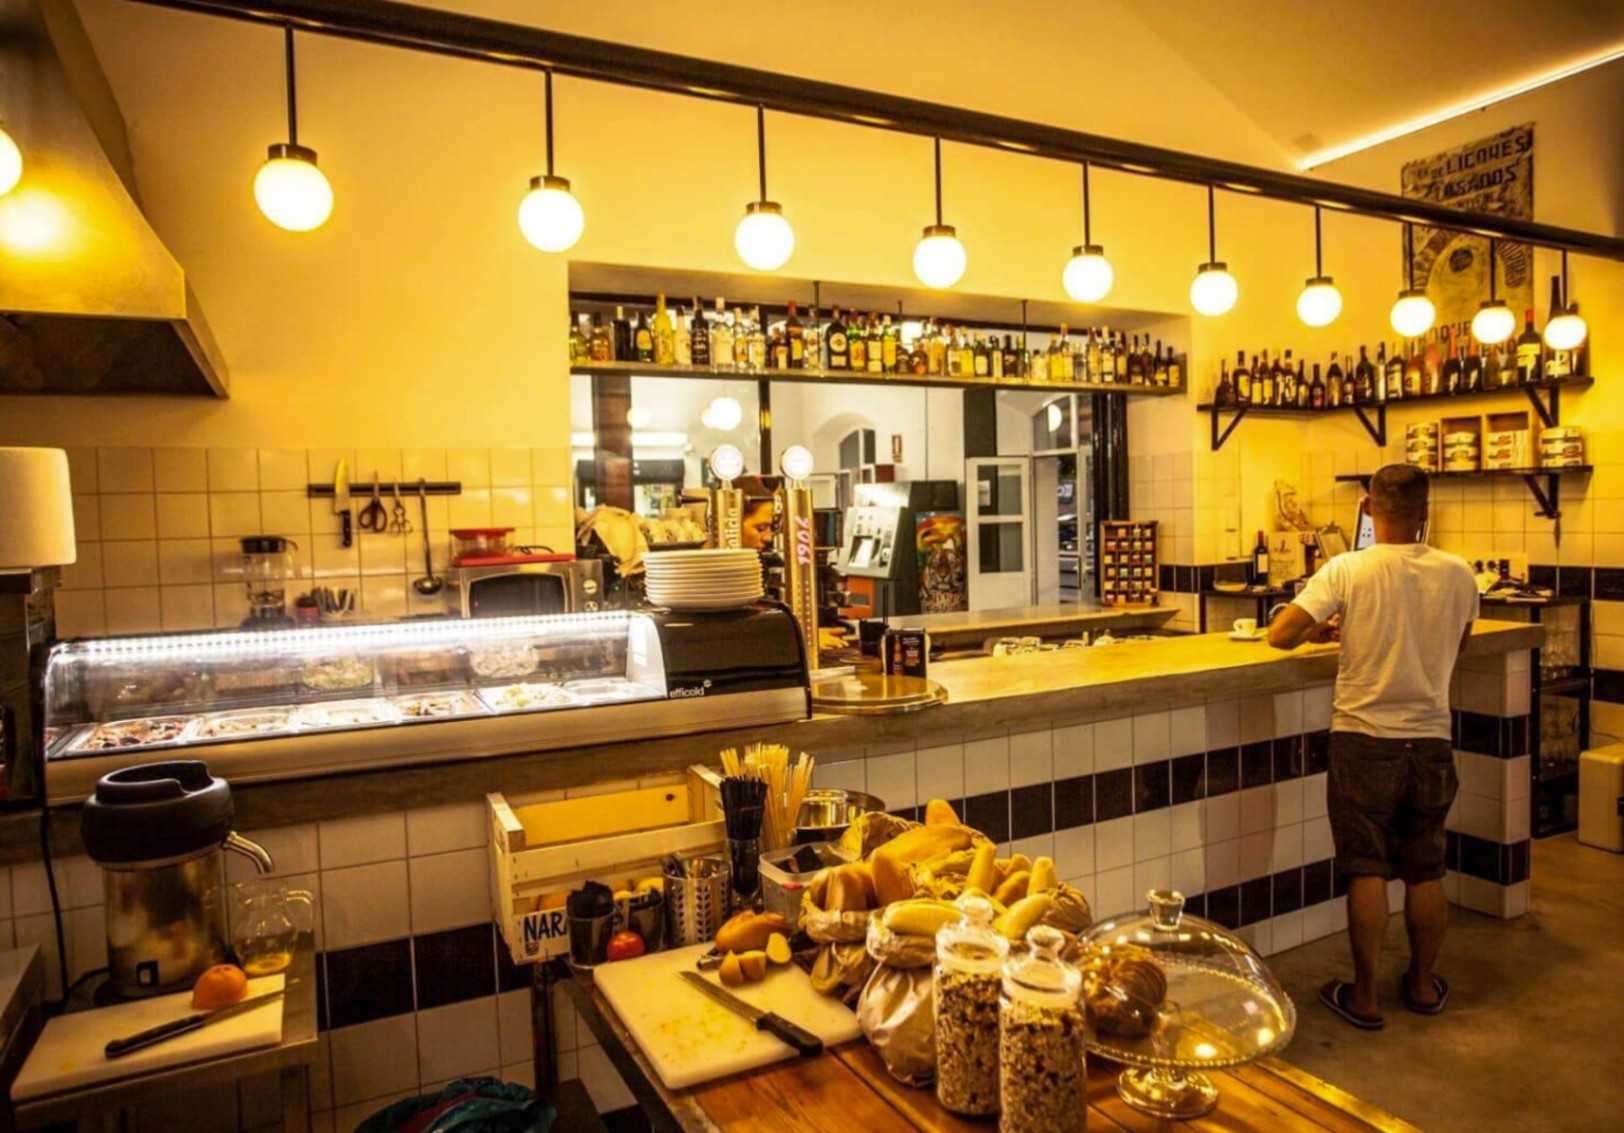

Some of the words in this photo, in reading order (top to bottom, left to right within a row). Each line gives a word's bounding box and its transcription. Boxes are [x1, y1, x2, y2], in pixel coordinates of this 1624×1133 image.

[1446, 135, 1525, 175] LICORES
[726, 507, 740, 550] alicia
[794, 515, 812, 565] 1906
[669, 686, 705, 698] efficold
